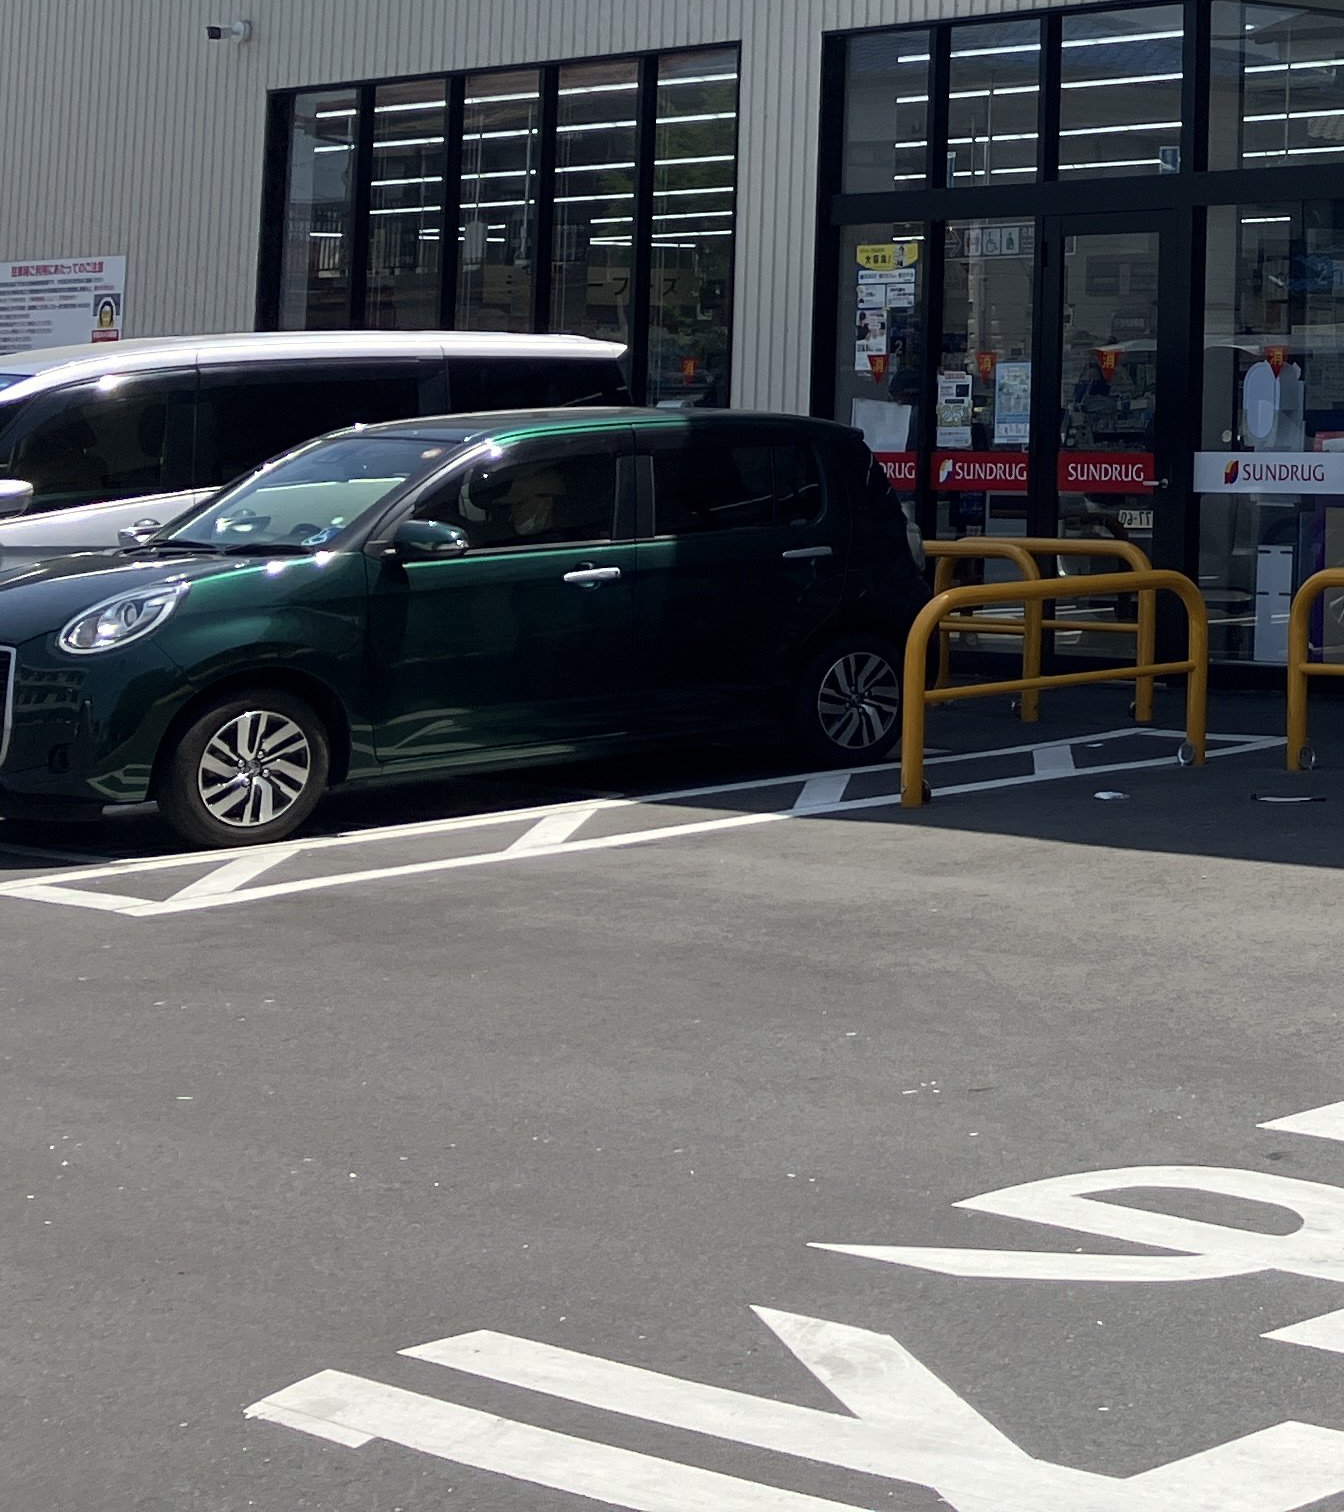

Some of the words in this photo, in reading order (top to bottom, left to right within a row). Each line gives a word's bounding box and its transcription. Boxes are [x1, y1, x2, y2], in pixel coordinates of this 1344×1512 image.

[878, 462, 916, 479] DRUG
[955, 462, 1028, 481] SUNDRUG
[1067, 463, 1145, 481] SUNDRUG
[1242, 462, 1325, 482] SUNDRUG
